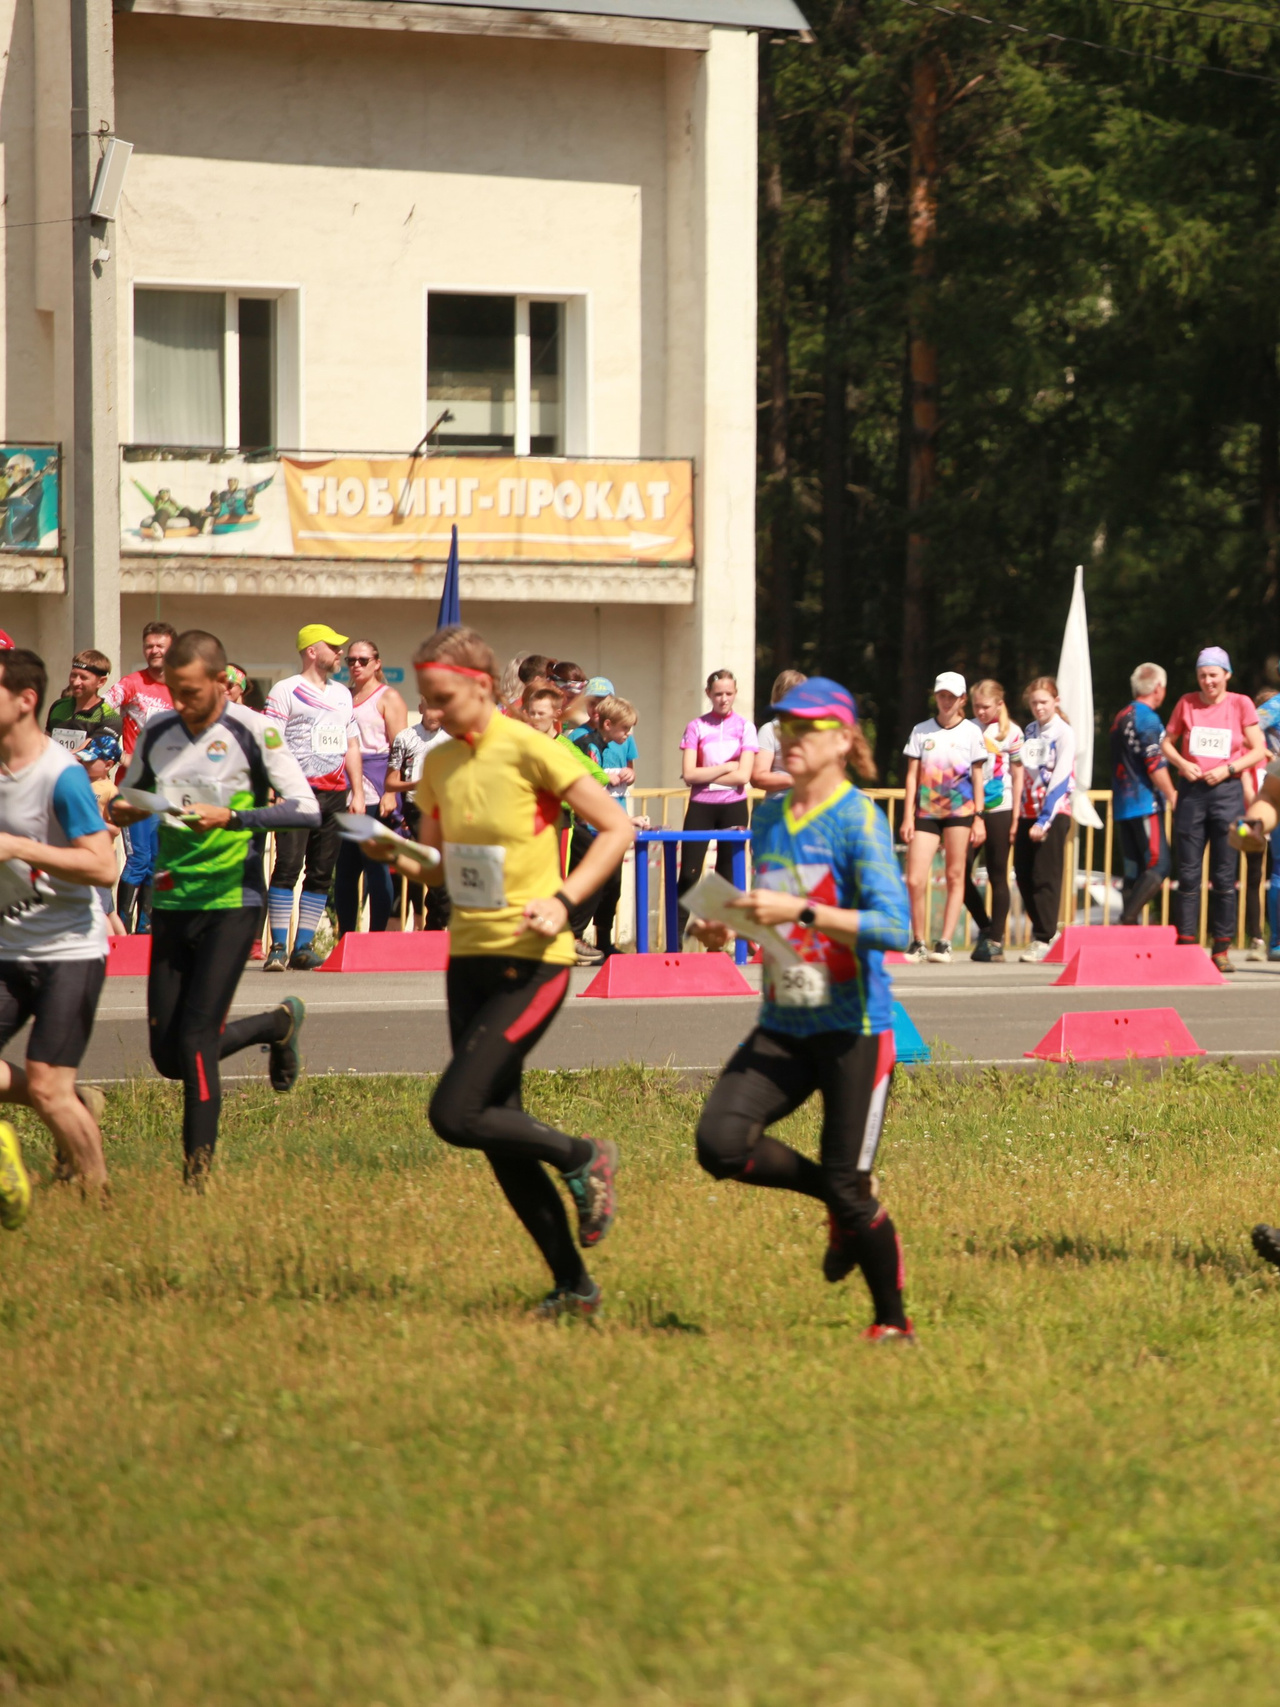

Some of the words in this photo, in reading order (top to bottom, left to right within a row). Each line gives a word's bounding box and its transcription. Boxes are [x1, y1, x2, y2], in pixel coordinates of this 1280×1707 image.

[301, 475, 671, 521] ТЮБИНГ-ПРОКАТ
[322, 735, 339, 746] 814
[1200, 737, 1220, 748] 912
